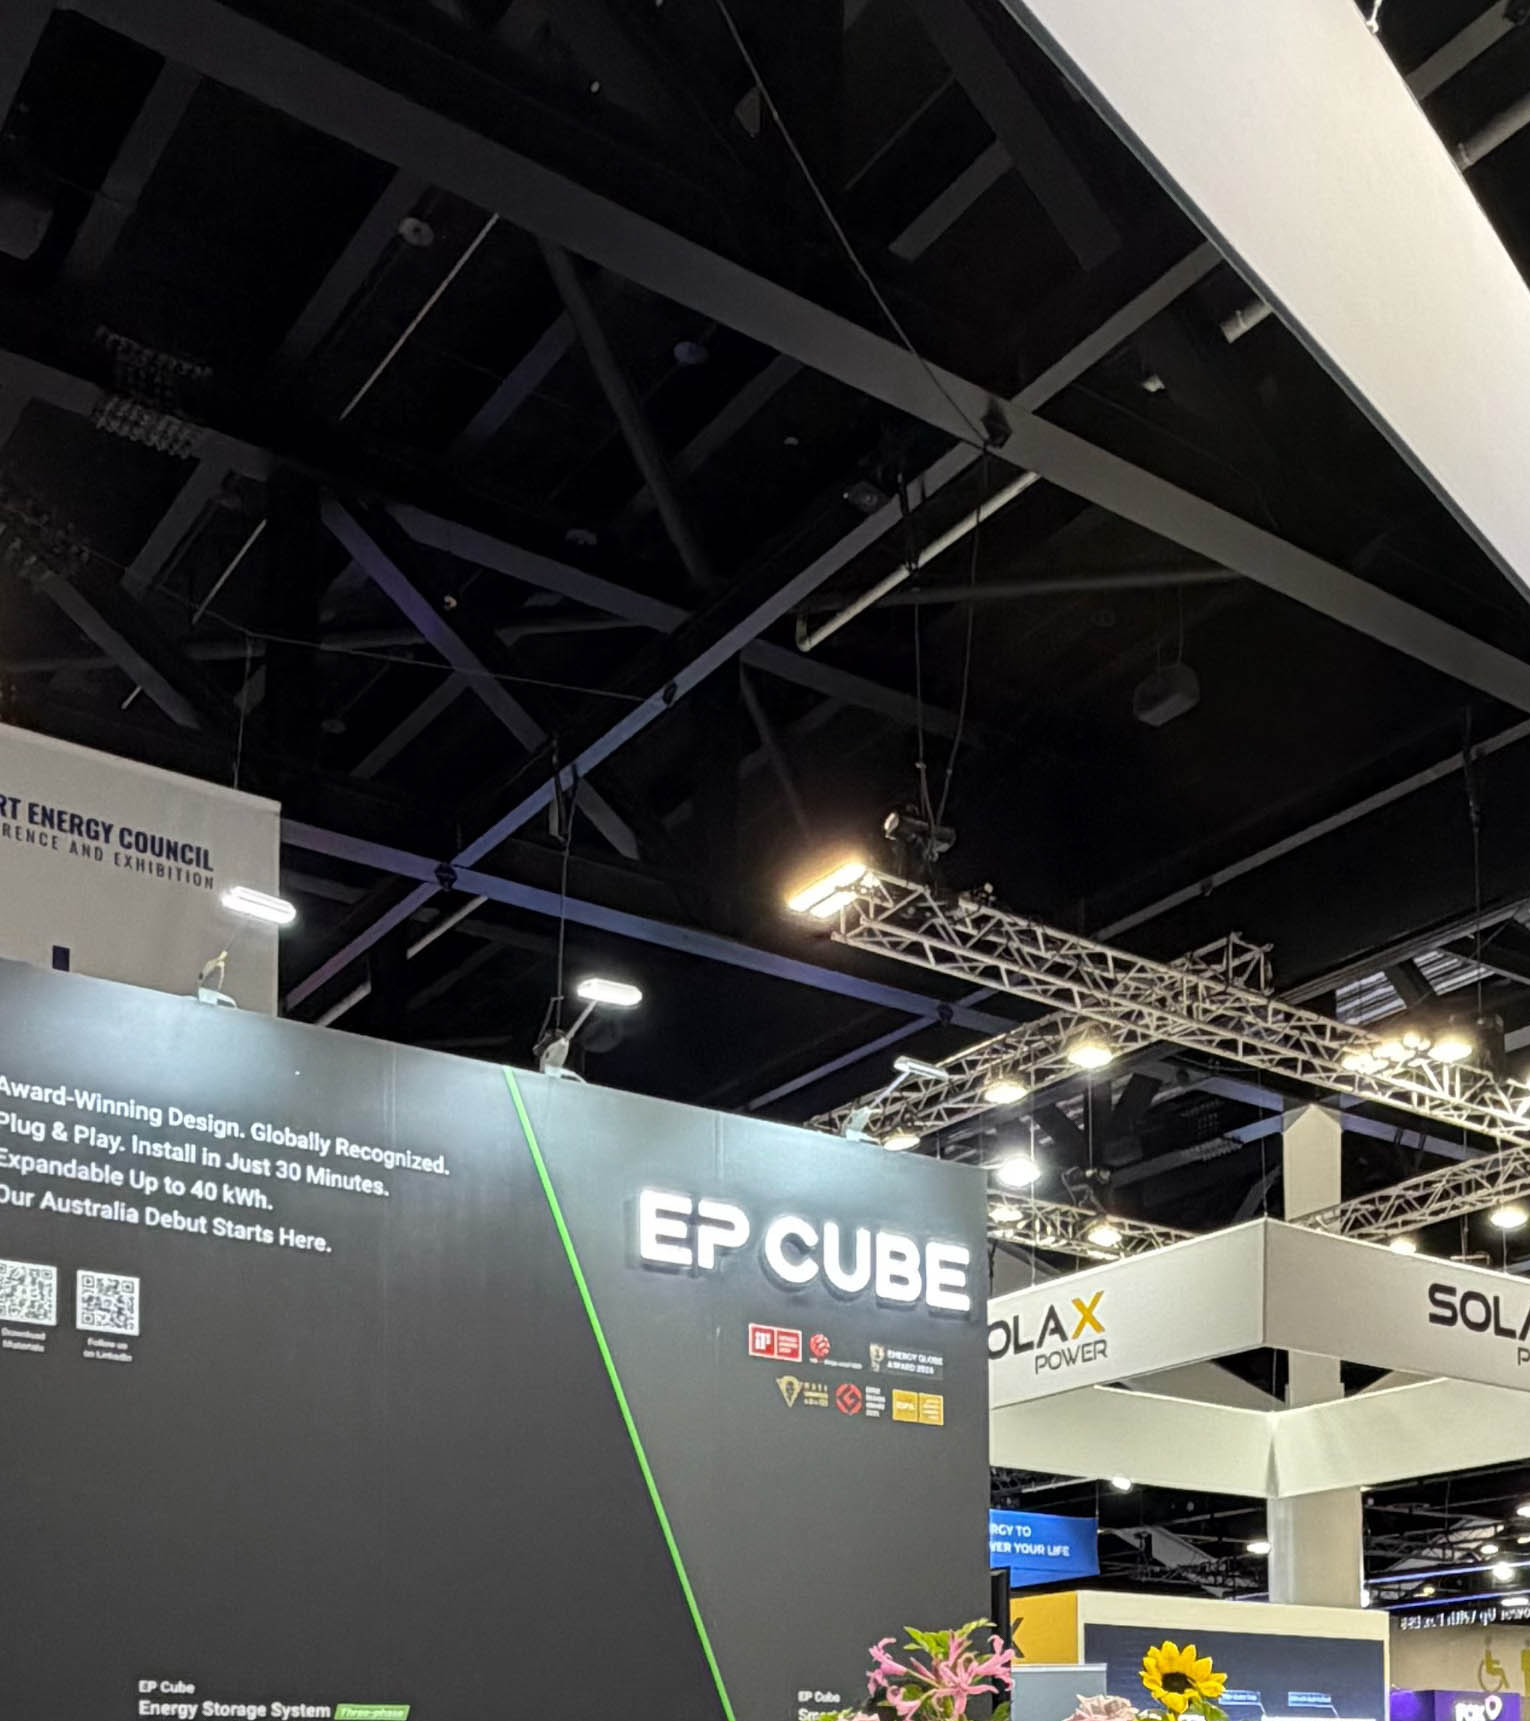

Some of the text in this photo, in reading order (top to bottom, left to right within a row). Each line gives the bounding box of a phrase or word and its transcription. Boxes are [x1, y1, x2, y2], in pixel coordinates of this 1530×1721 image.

[28, 802, 113, 844] ENERGY
[118, 827, 214, 871] COUNCIL
[69, 843, 103, 862] AND
[114, 852, 214, 890] EXHIBITION
[0, 1075, 450, 1176] Award-Winning Design. Globally Recognized.
[0, 1111, 390, 1197] Plug & Play. Install in Just 30 Minutes.
[0, 1147, 275, 1210] Expandable Up to 40 kWh.
[39, 1191, 140, 1224] Australia
[145, 1207, 208, 1235] Debut
[212, 1217, 274, 1245] Starts
[279, 1227, 333, 1253] Here.
[639, 1190, 970, 1311] EP CUBE
[1034, 1338, 1109, 1376] POWER
[1014, 1542, 1045, 1556] YOUR
[1047, 1545, 1070, 1558] LIFE
[138, 1680, 196, 1695] EP Cube
[138, 1700, 199, 1720] Energy
[201, 1700, 267, 1721] Storage
[270, 1701, 331, 1721] System
